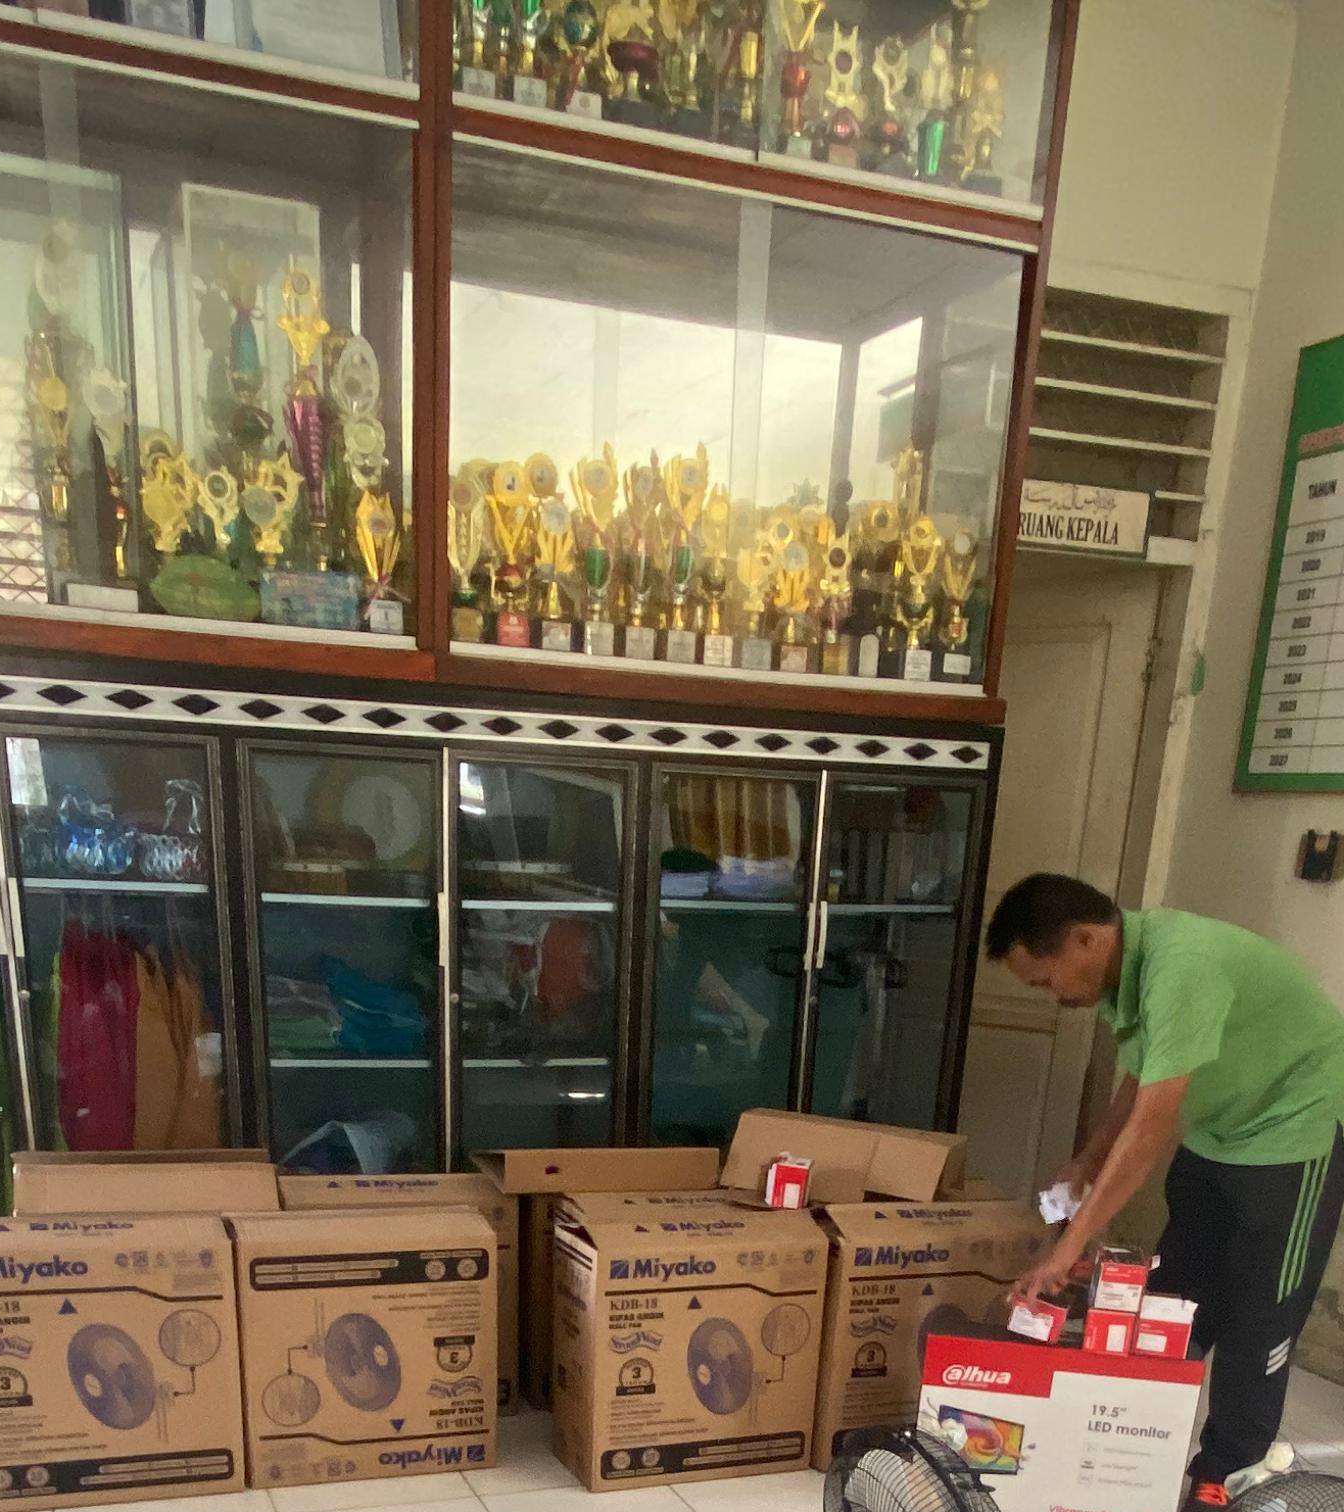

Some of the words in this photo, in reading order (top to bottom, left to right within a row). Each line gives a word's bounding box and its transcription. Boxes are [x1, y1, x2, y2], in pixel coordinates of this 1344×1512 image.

[1308, 480, 1338, 500] TAHUN
[1019, 511, 1065, 539] RUANG
[1066, 516, 1119, 545] KEPALA
[51, 1221, 135, 1232] Miyako
[874, 1243, 951, 1269] Miyako
[632, 1255, 717, 1282] Miyako
[610, 1297, 658, 1311] KDB-18
[632, 1366, 642, 1379] 3
[0, 1376, 12, 1391] 3
[1087, 1420, 1113, 1433] LED
[1116, 1425, 1172, 1440] monitor
[378, 1444, 464, 1468] Miyako
